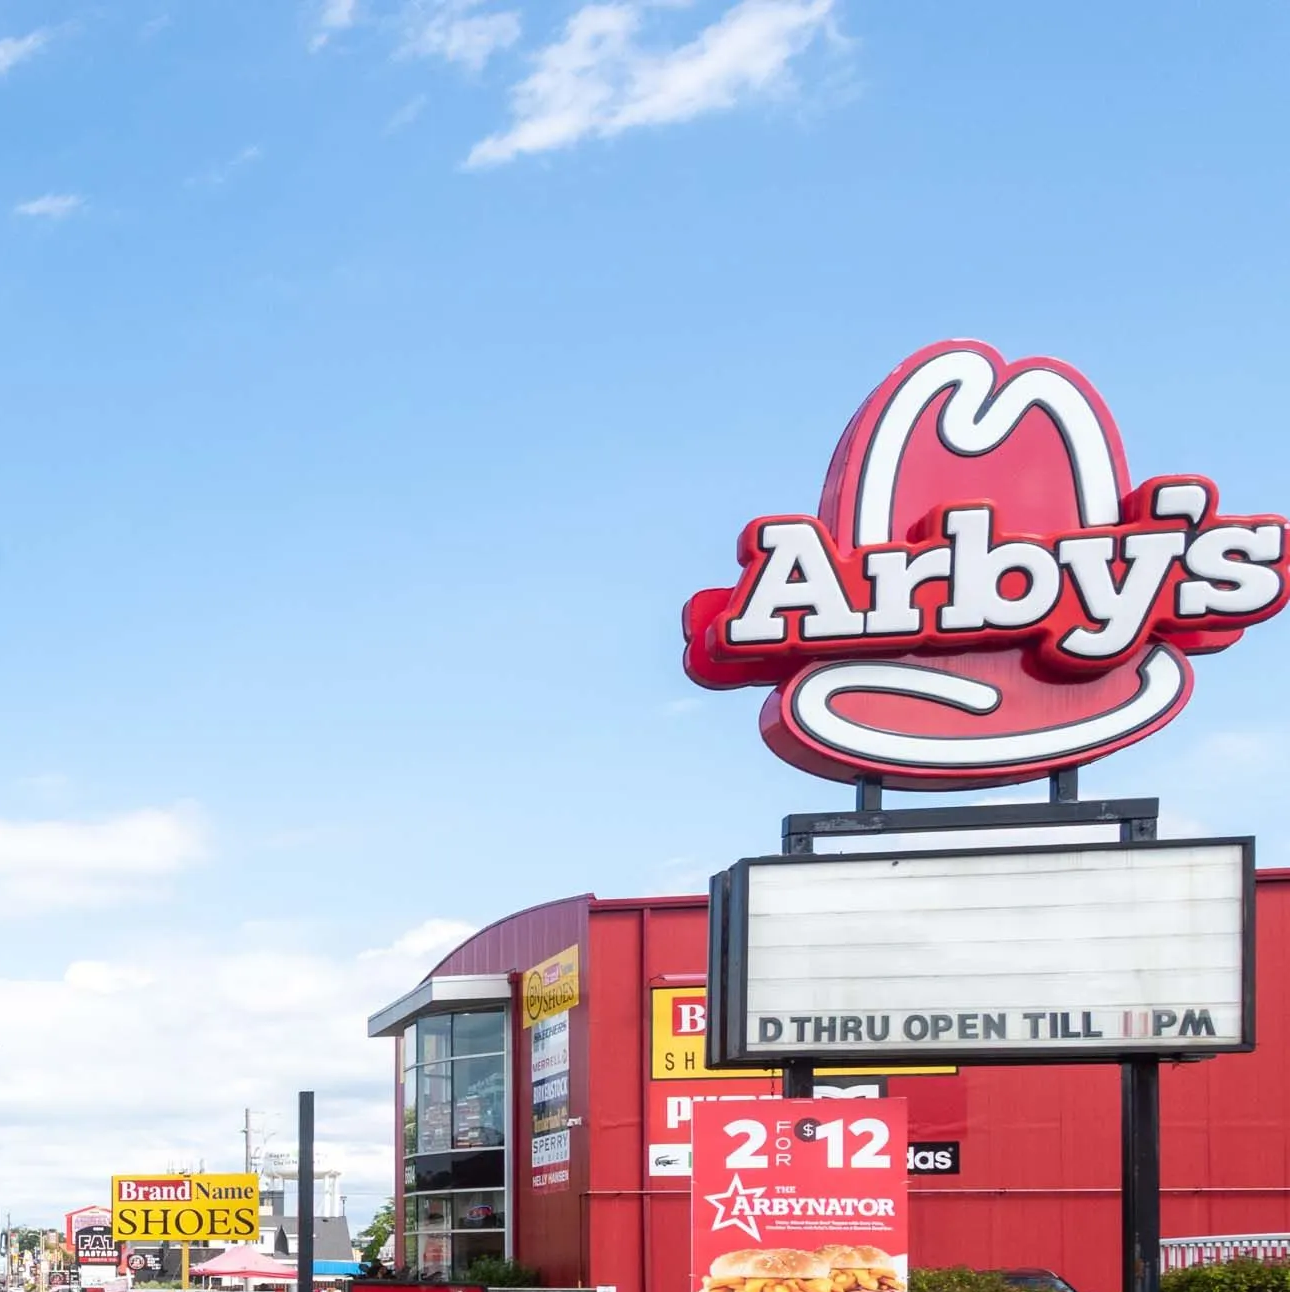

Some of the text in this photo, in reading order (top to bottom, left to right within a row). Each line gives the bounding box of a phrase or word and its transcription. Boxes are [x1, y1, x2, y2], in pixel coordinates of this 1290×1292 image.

[724, 484, 1283, 661] Arby's
[759, 1016, 783, 1042] D
[790, 1014, 890, 1042] THRU
[902, 1012, 1007, 1041] OPEN
[1023, 1010, 1102, 1040] TILL
[533, 1133, 568, 1154] SPERRY
[723, 1119, 769, 1169] 2
[775, 1120, 792, 1167] FOR
[907, 1147, 953, 1170] das
[119, 1181, 254, 1200] Brand Name
[775, 1186, 796, 1194] THE
[731, 1197, 896, 1217] ARBYNATOR
[117, 1208, 255, 1236] SHOES
[79, 1235, 116, 1250] FAT
